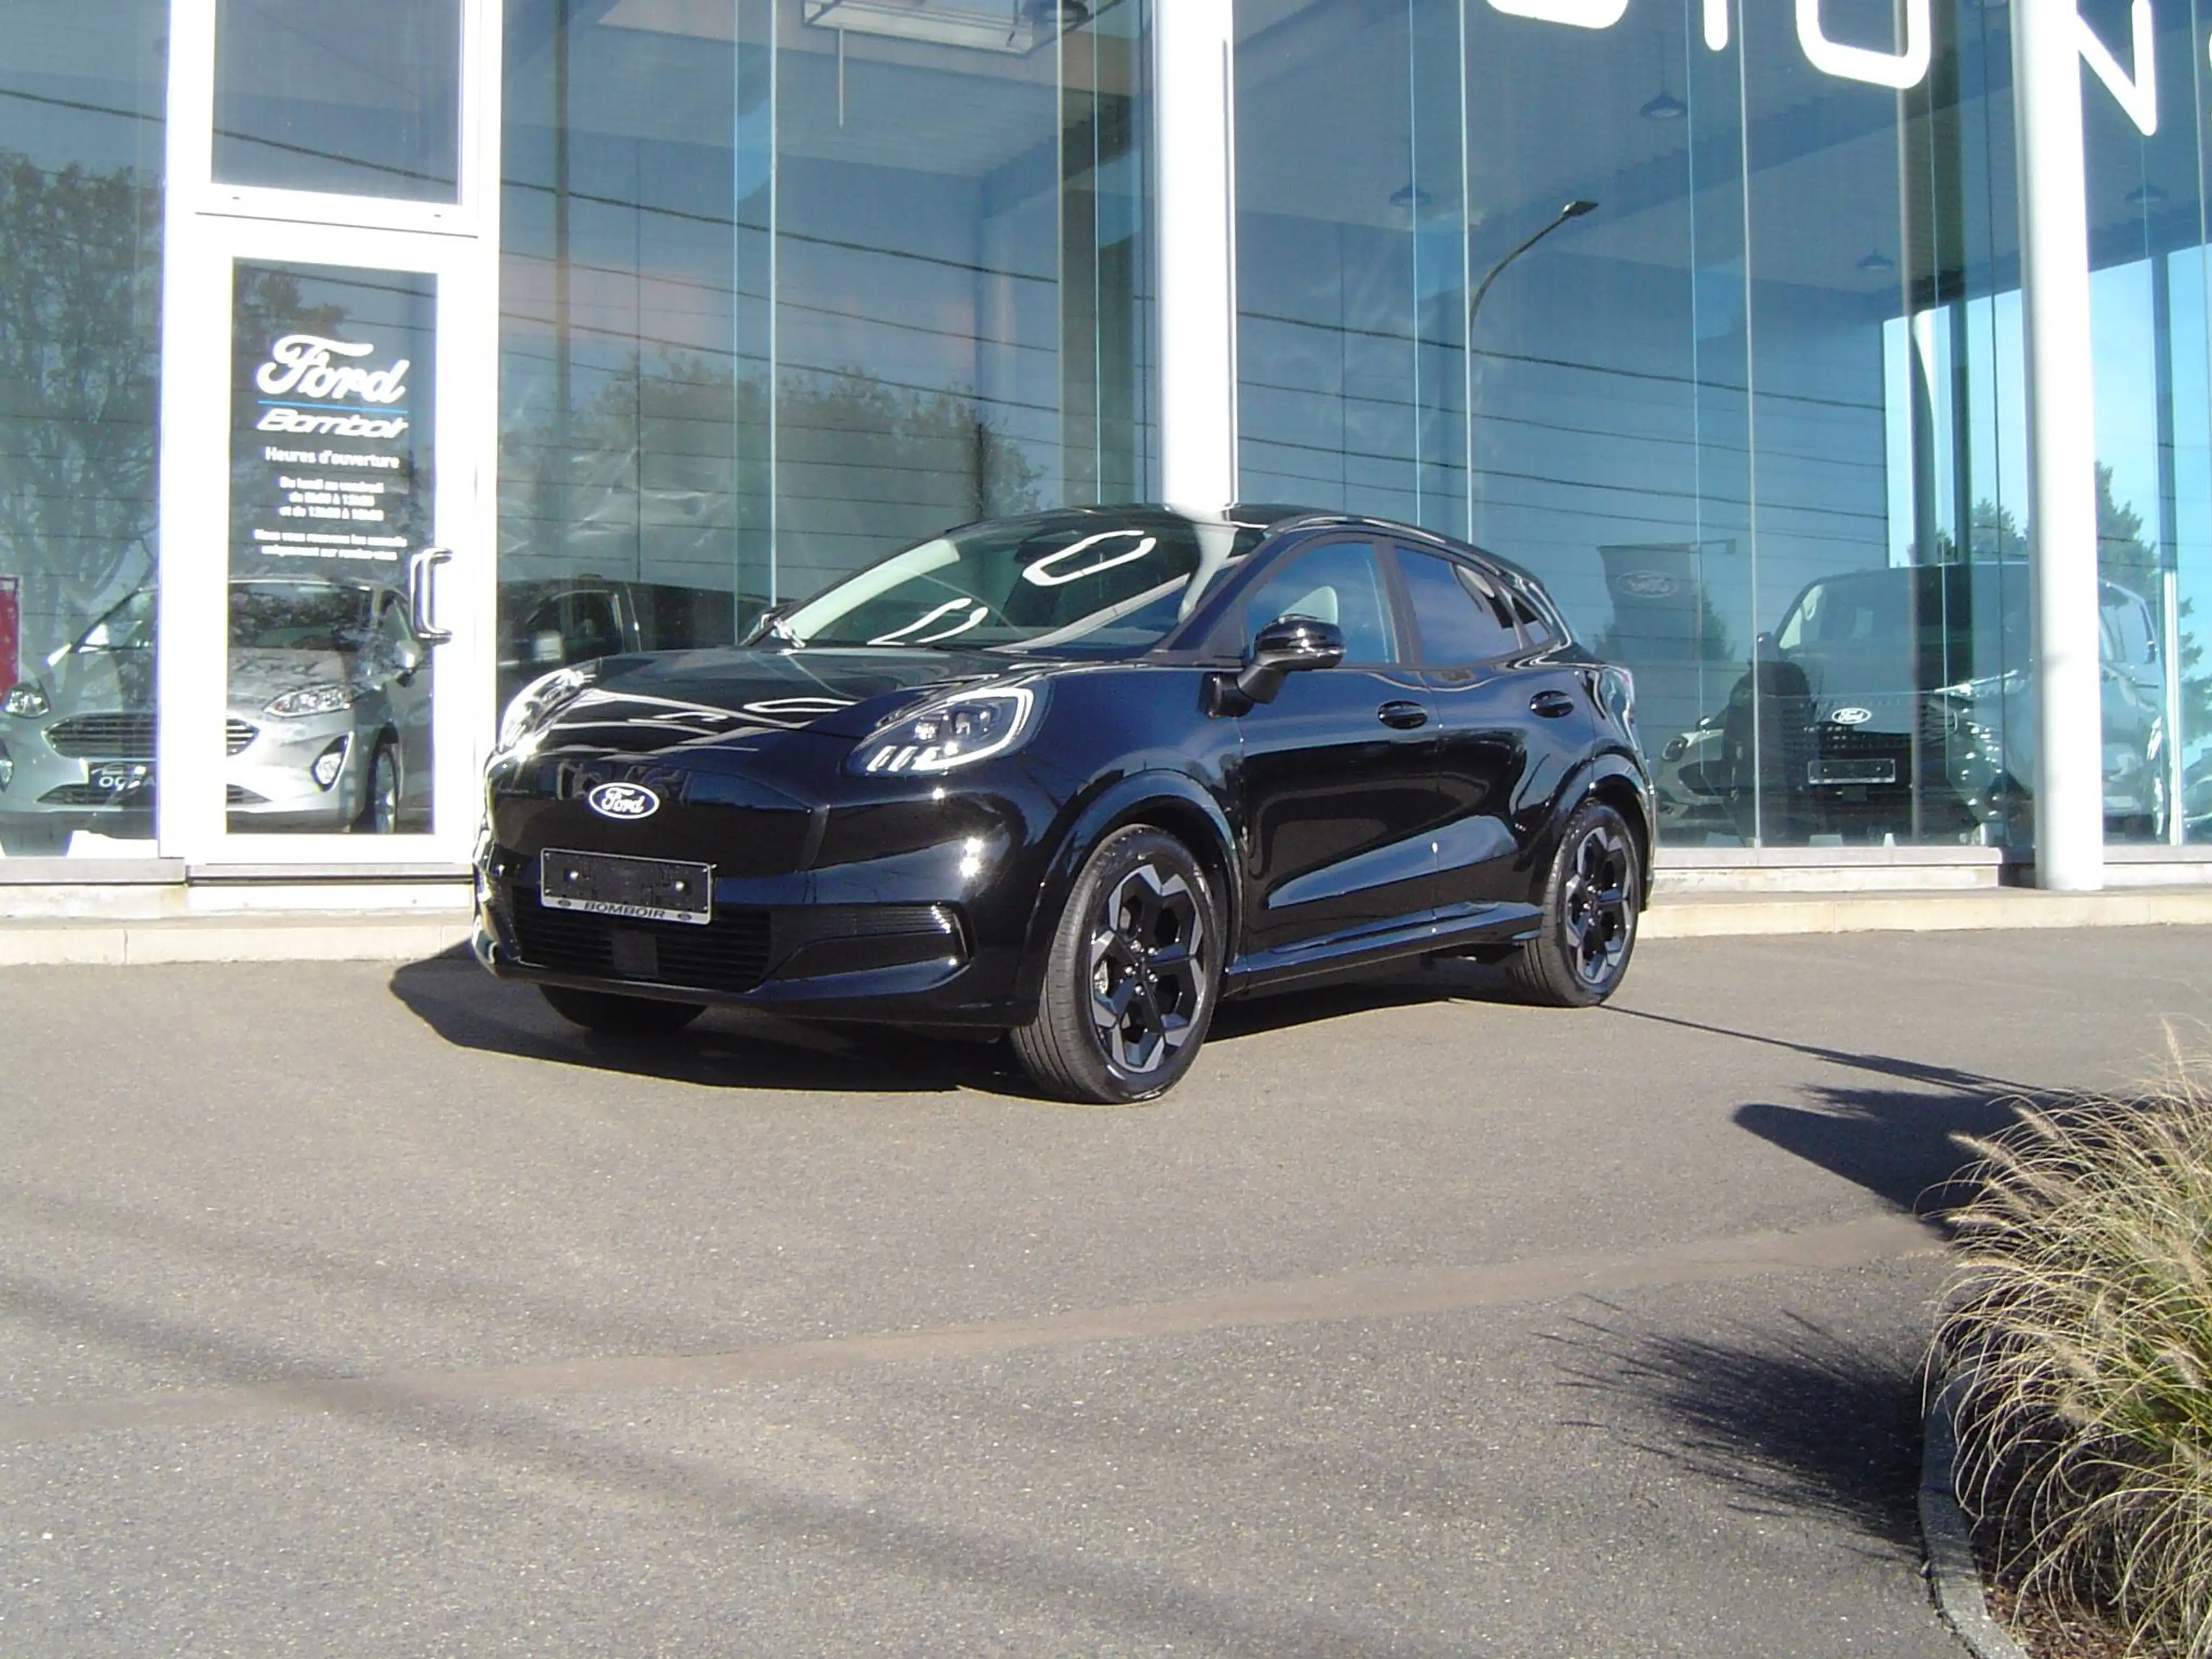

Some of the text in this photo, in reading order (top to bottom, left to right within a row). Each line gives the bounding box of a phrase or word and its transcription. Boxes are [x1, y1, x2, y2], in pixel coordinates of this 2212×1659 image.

[256, 334, 410, 403] Ford
[265, 446, 400, 468] Heures d'ouverture
[601, 787, 645, 813] Ford
[584, 902, 665, 918] BOMBOIR
